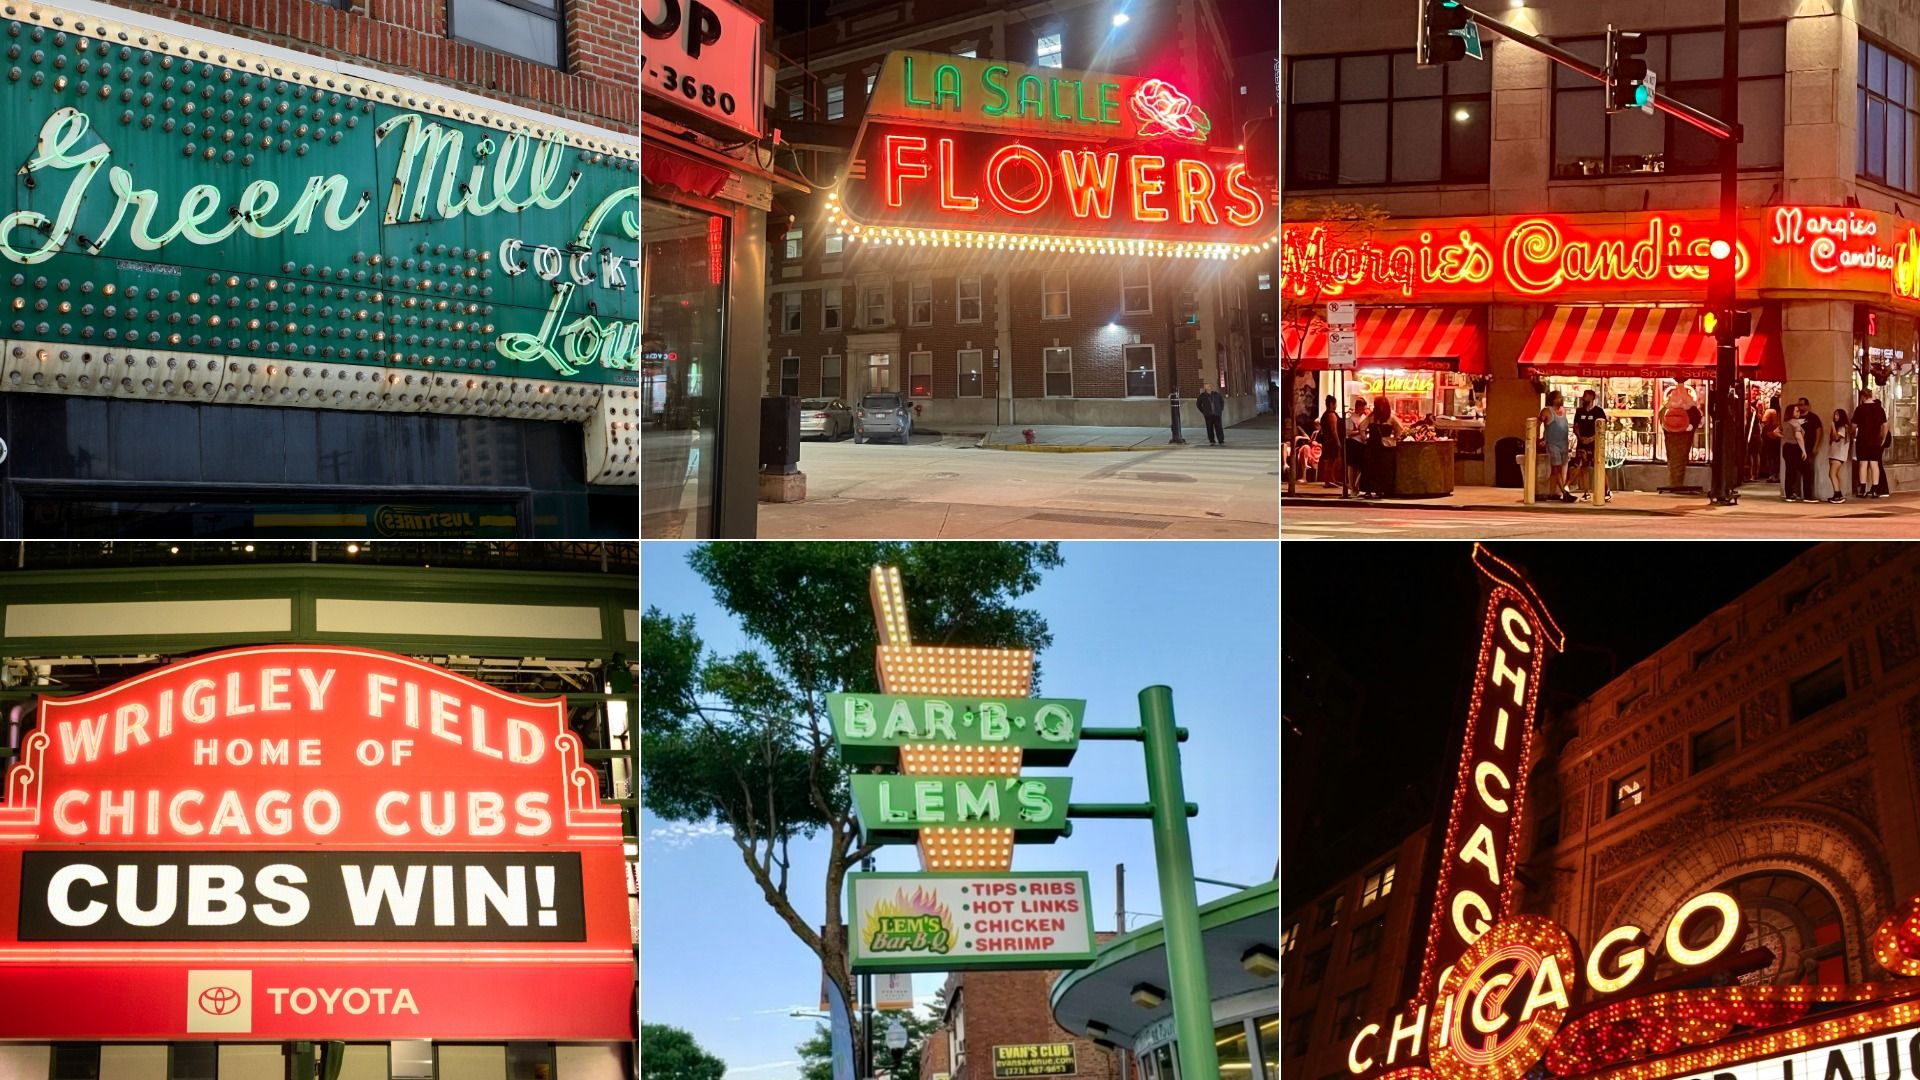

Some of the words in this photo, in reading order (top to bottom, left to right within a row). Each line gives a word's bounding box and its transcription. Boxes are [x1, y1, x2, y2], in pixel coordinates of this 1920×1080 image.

[904, 56, 962, 110] LA
[981, 64, 1121, 124] SALLE
[0, 106, 372, 264] Green
[375, 113, 583, 226] Mill
[886, 134, 1264, 227] FLOWERS
[1772, 207, 1877, 244] Margies
[1503, 218, 1748, 295] Candie
[1810, 237, 1894, 273] Candies
[1582, 368, 1635, 377] Banana
[57, 667, 337, 765] WRIGLEY
[367, 672, 546, 765] FIELD
[193, 738, 322, 766] HOME
[356, 738, 415, 766] OF
[52, 789, 342, 837] CHICAGO
[374, 790, 553, 837] CUBS
[879, 777, 1053, 823] LEM'S
[1440, 606, 1533, 994] CHICAG
[46, 863, 311, 928] CUBS
[340, 864, 558, 928] WIN!
[972, 883, 1017, 896] TIPS
[1030, 882, 1076, 895] RIBS
[972, 900, 1014, 914] HOT
[1021, 899, 1080, 913] LINKS
[879, 916, 941, 933] LEM'S
[974, 918, 1065, 933] CHICKEN
[975, 937, 1055, 951] SHRIMP
[266, 987, 419, 1015] TOYOTA
[1348, 891, 1740, 1075] CHICAGO
[996, 1057, 1074, 1068] evansavenue.com
[998, 1046, 1039, 1059] EVAN'S
[1040, 1044, 1070, 1057] CLUB
